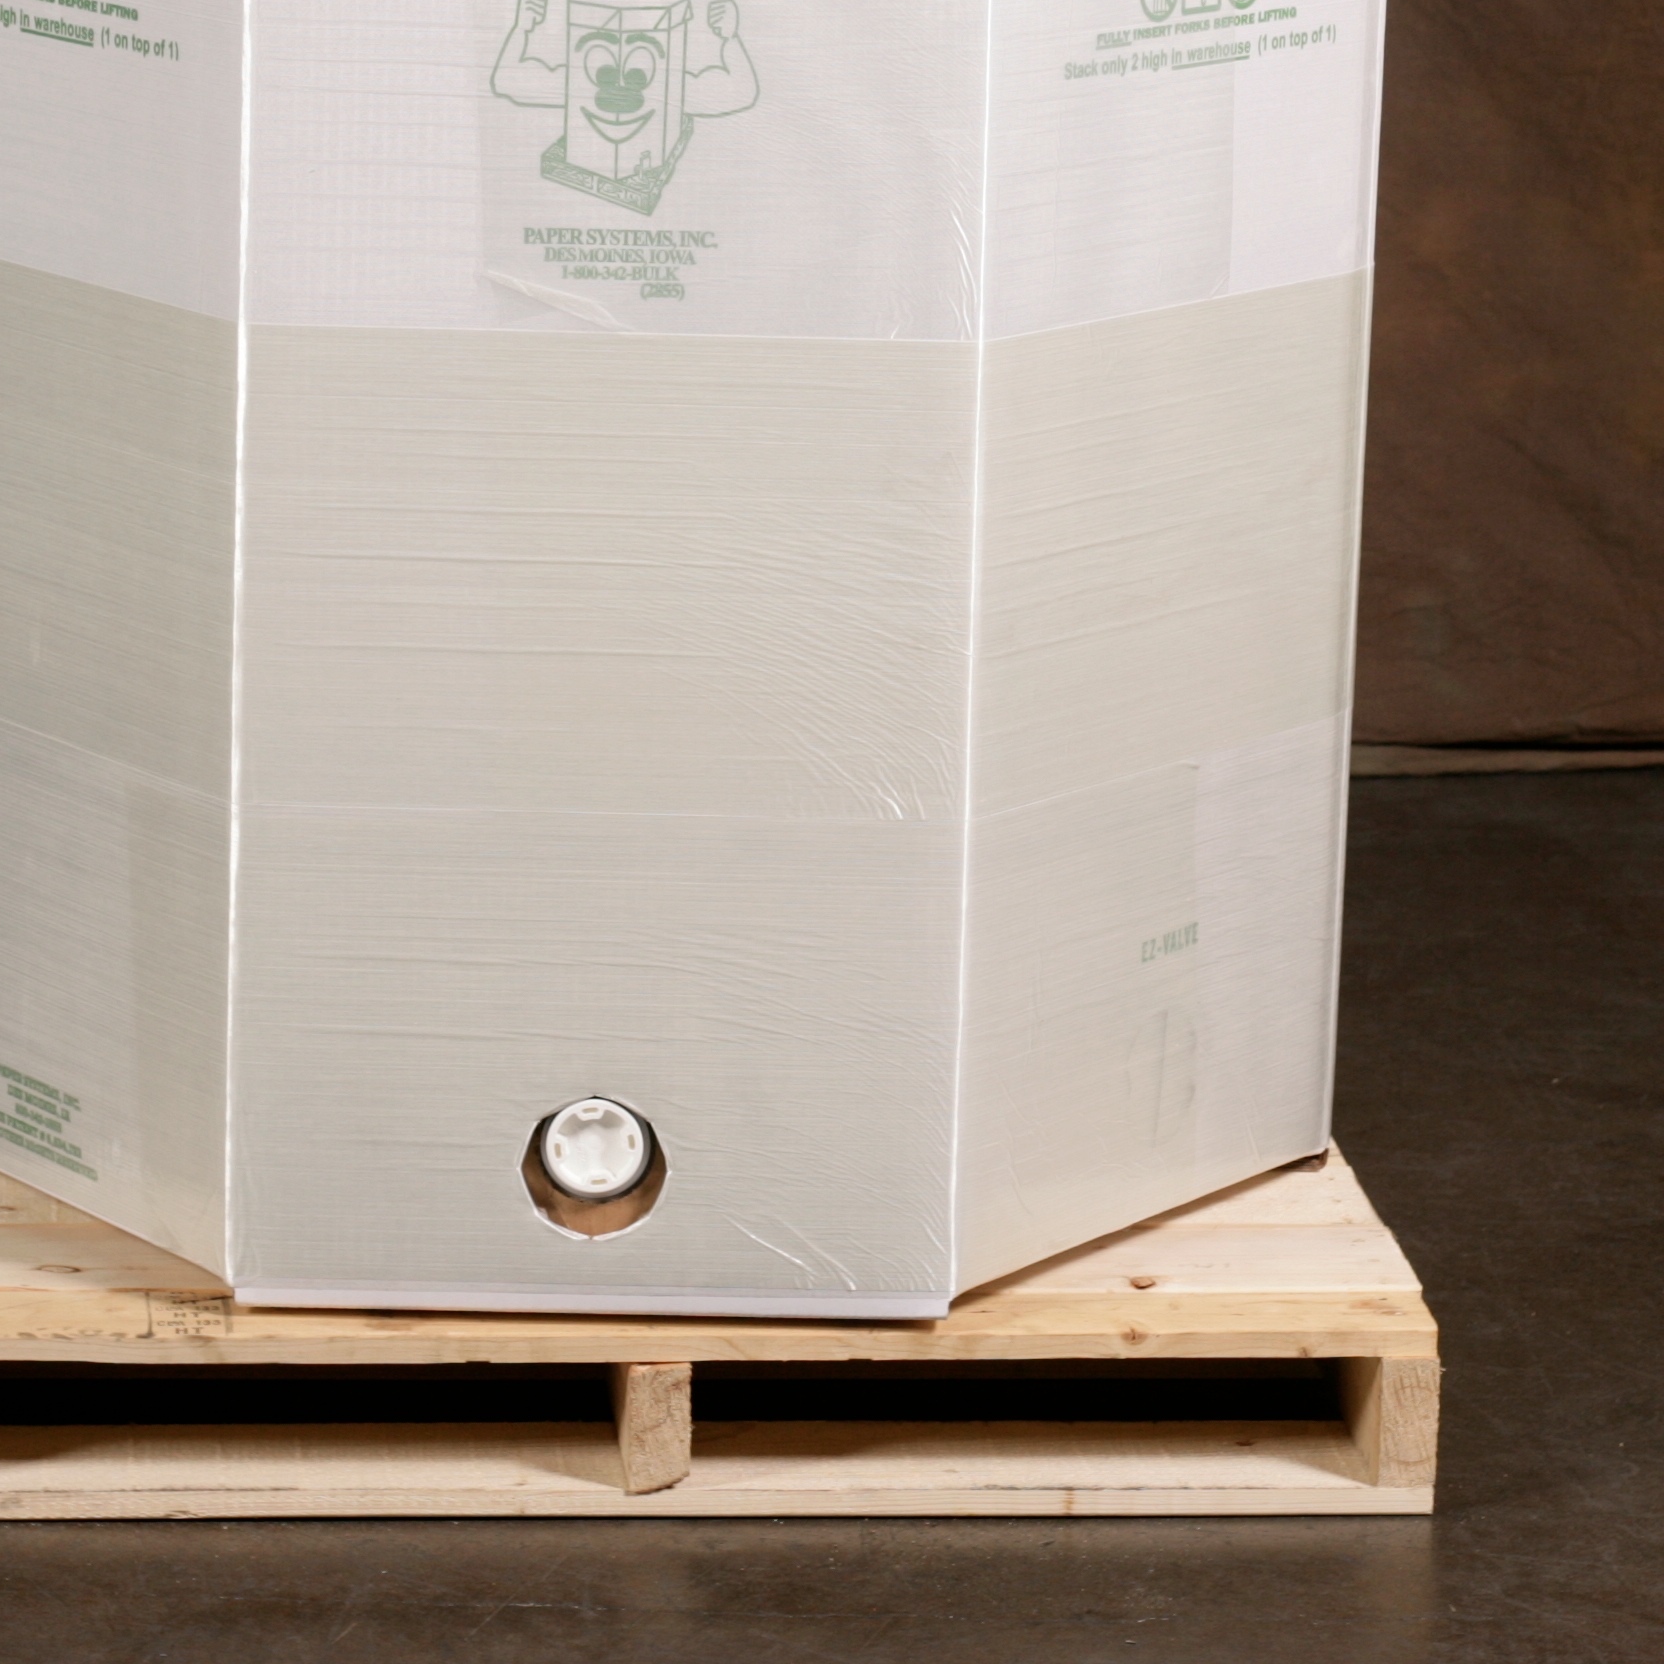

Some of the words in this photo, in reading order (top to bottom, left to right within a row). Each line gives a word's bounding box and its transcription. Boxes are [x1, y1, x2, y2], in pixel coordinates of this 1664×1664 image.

[100, 2, 139, 22] LIFTING
[1096, 30, 1132, 48] FULLY
[1133, 24, 1173, 43] INSERT
[1174, 18, 1211, 36] FORKS
[1213, 12, 1255, 31] BEFORE
[1258, 6, 1297, 24] LIFTING
[19, 8, 30, 28] in
[35, 14, 95, 42] warehouse
[114, 30, 128, 49] on
[131, 34, 150, 57] top
[153, 39, 165, 58] of
[1064, 58, 1098, 80] Stack
[1101, 56, 1128, 78] only
[1131, 53, 1139, 71] 2
[1141, 48, 1168, 72] high
[1171, 46, 1183, 66] in
[1187, 40, 1251, 64] warehouse
[1271, 35, 1286, 50] on
[1289, 30, 1309, 49] top
[1311, 25, 1325, 44] of
[523, 227, 584, 245] PAPER
[586, 228, 677, 249] SYSTEMS,
[679, 230, 718, 249] INC.
[543, 247, 576, 262] DES
[578, 247, 647, 266] MOINES,
[649, 250, 697, 265] IOWA
[1141, 922, 1199, 963] EZ-VALVE
